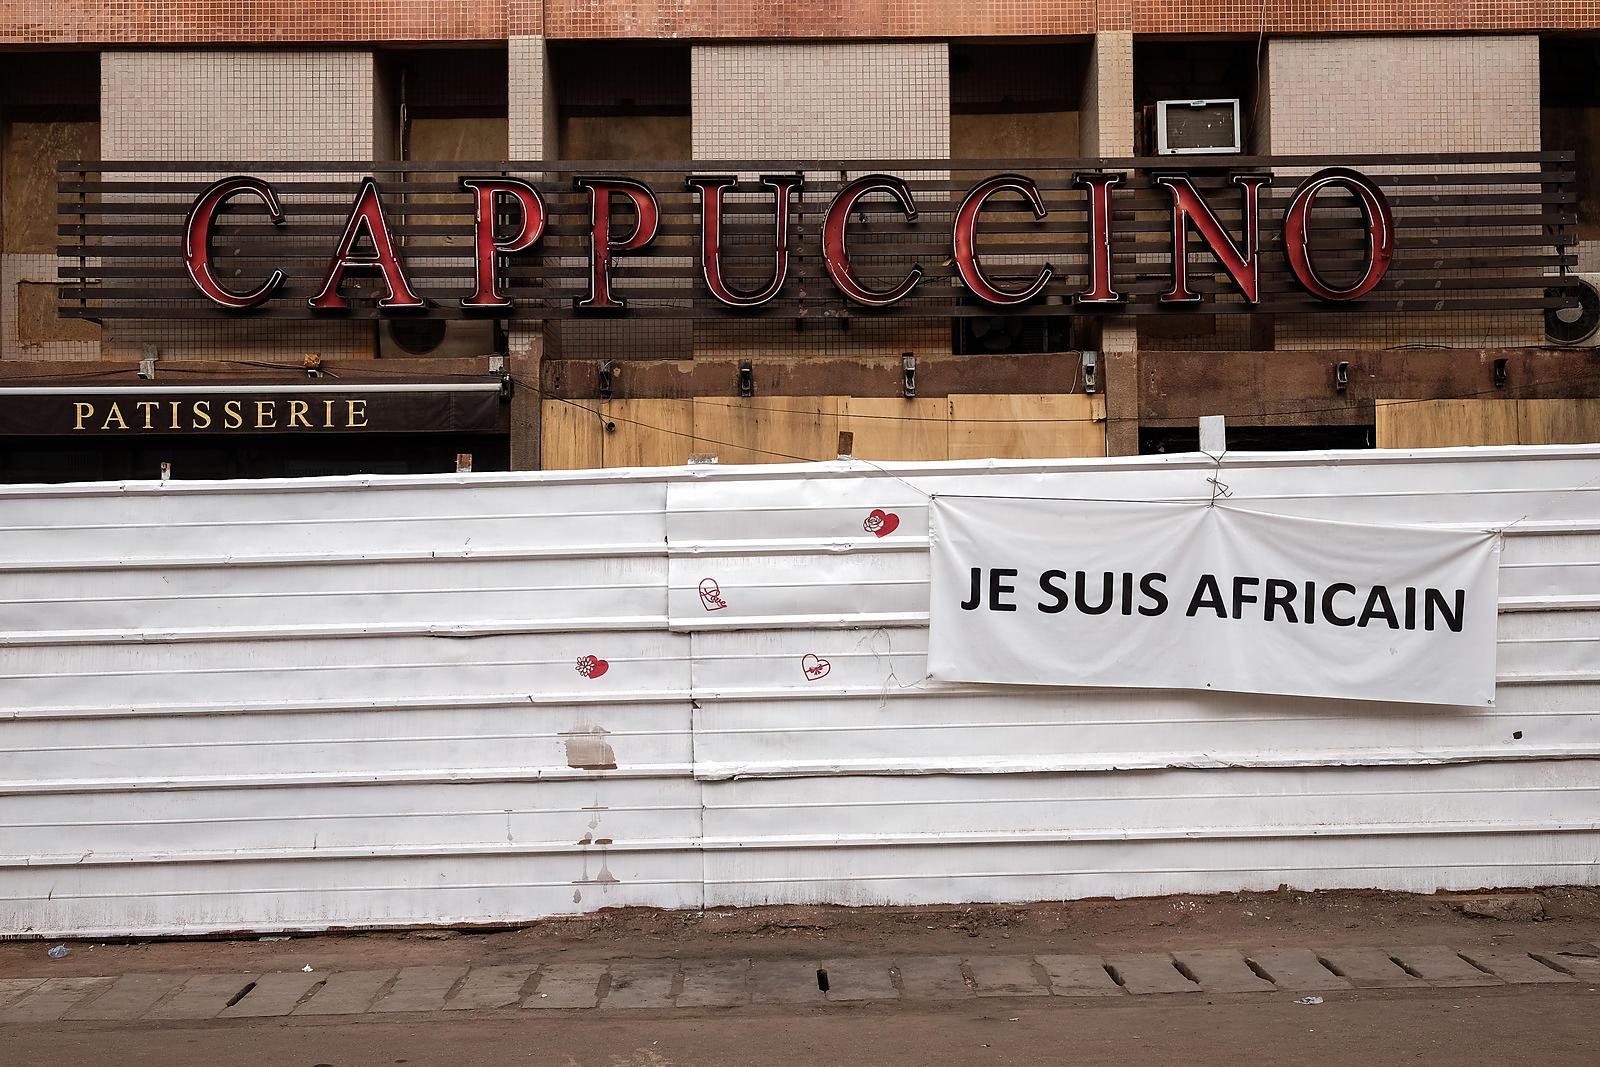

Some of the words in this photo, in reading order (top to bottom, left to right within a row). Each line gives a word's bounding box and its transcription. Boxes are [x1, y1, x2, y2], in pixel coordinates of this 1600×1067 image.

[183, 167, 1394, 310] CAPPUCCINO
[73, 399, 369, 430] PATISSERIE
[961, 566, 1018, 612] JE
[1037, 569, 1169, 617] SUIS
[1185, 573, 1466, 633] AFRICAIN
